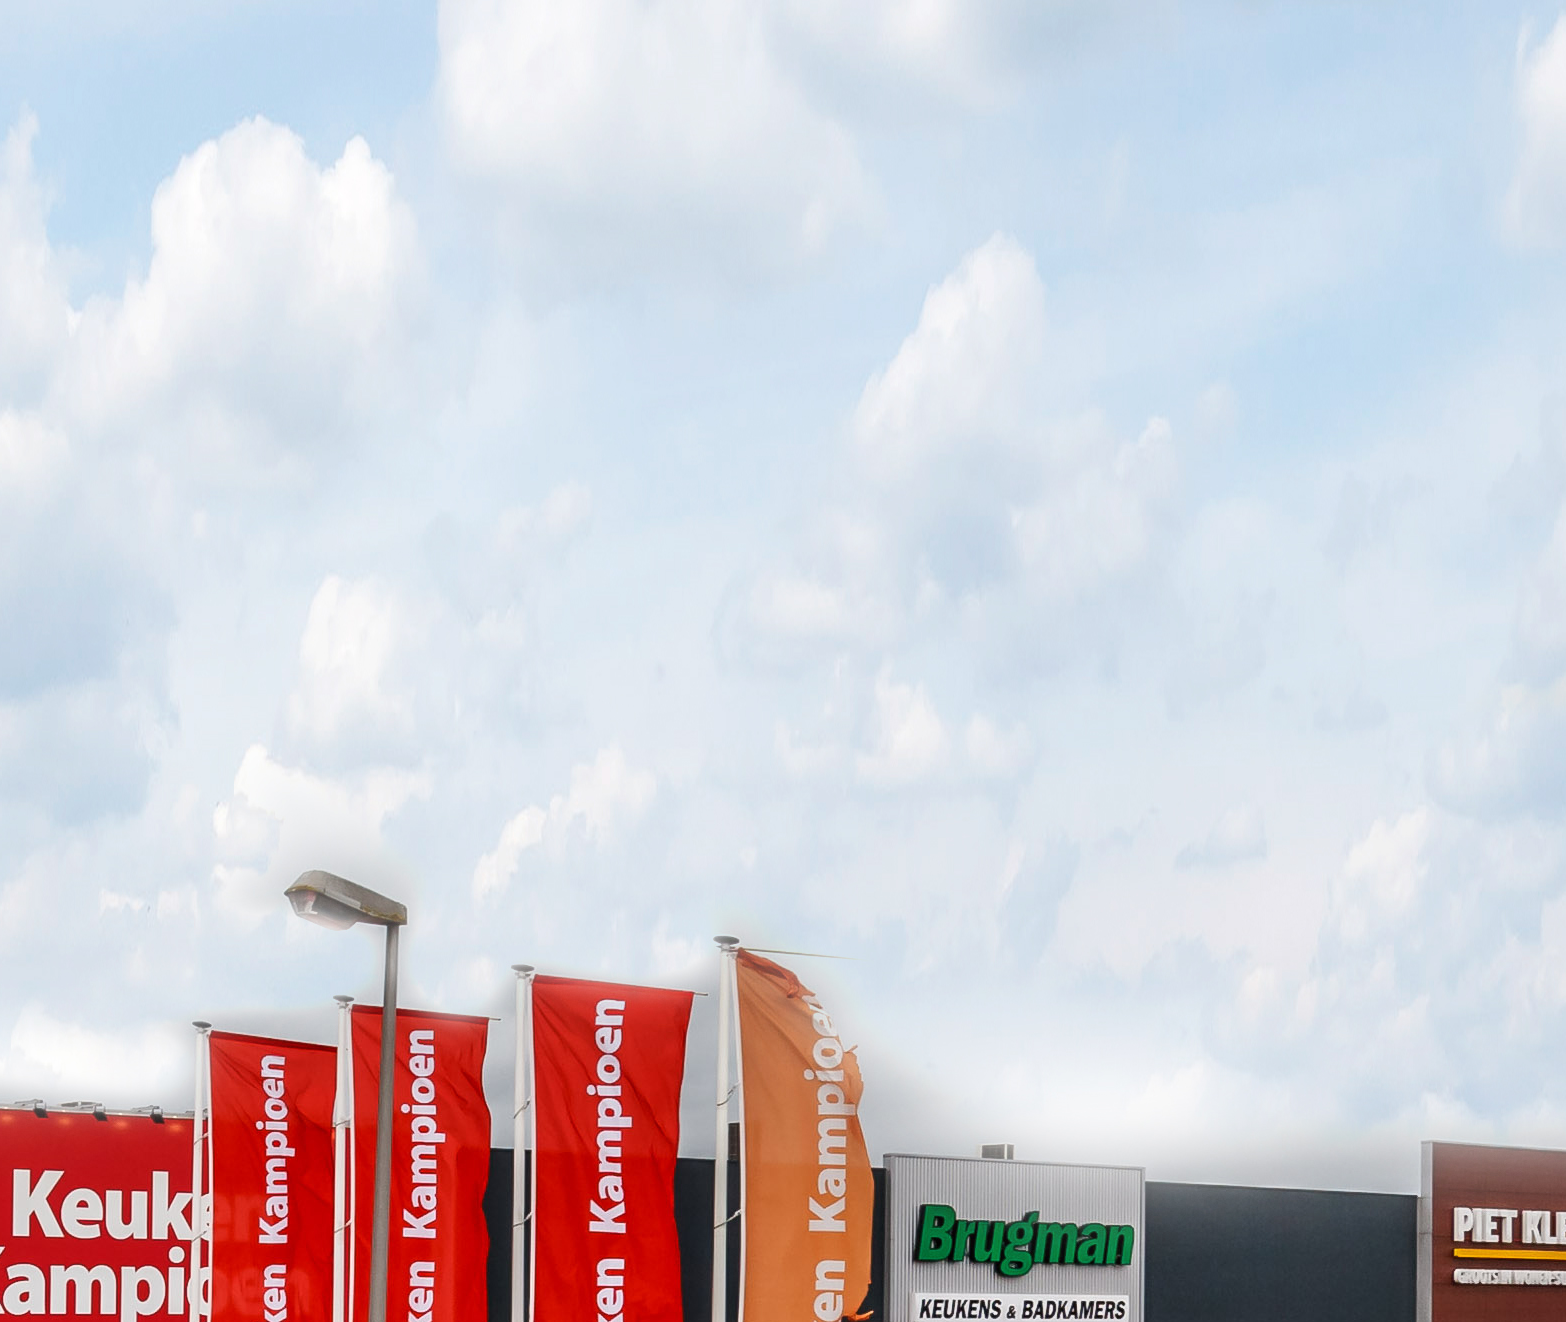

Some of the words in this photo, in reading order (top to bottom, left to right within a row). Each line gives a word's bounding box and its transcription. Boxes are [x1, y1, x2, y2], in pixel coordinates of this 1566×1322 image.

[255, 1055, 296, 1244] Kampioen
[400, 1030, 446, 1239] Kampioen
[586, 999, 633, 1234] Kampioen
[914, 1203, 1134, 1276] Brugman
[1453, 1206, 1518, 1244] PIET
[919, 1299, 1001, 1320] KEUKENS
[1006, 1306, 1016, 1319] &
[1021, 1300, 1126, 1320] BADKAMERS
